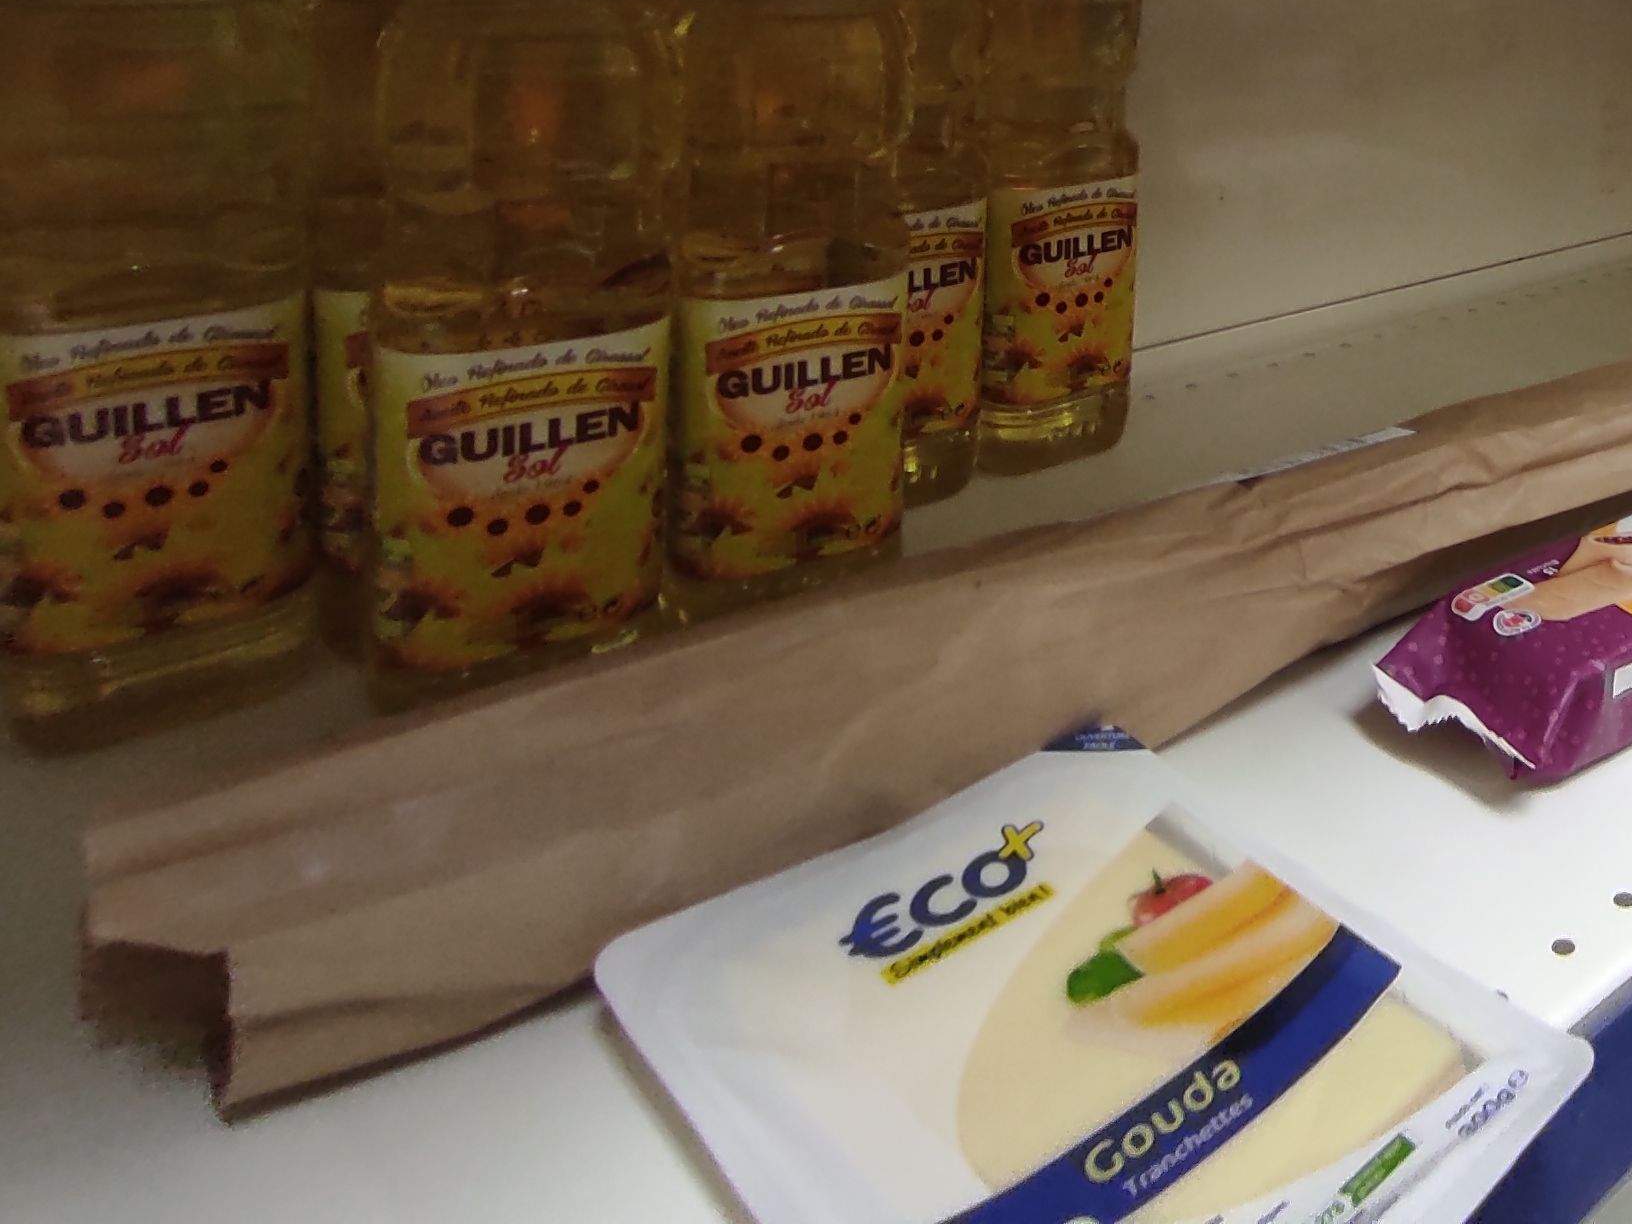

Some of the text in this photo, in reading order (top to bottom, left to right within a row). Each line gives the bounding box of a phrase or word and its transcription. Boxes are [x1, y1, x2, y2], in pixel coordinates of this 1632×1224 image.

[908, 256, 976, 293] LLEN
[1019, 225, 1133, 265] GUILLEN
[718, 343, 891, 399] GUILLEN
[21, 376, 272, 448] GUILLEN
[418, 400, 640, 466] GUILLEN
[1122, 1092, 1255, 1198] Tranchettes
